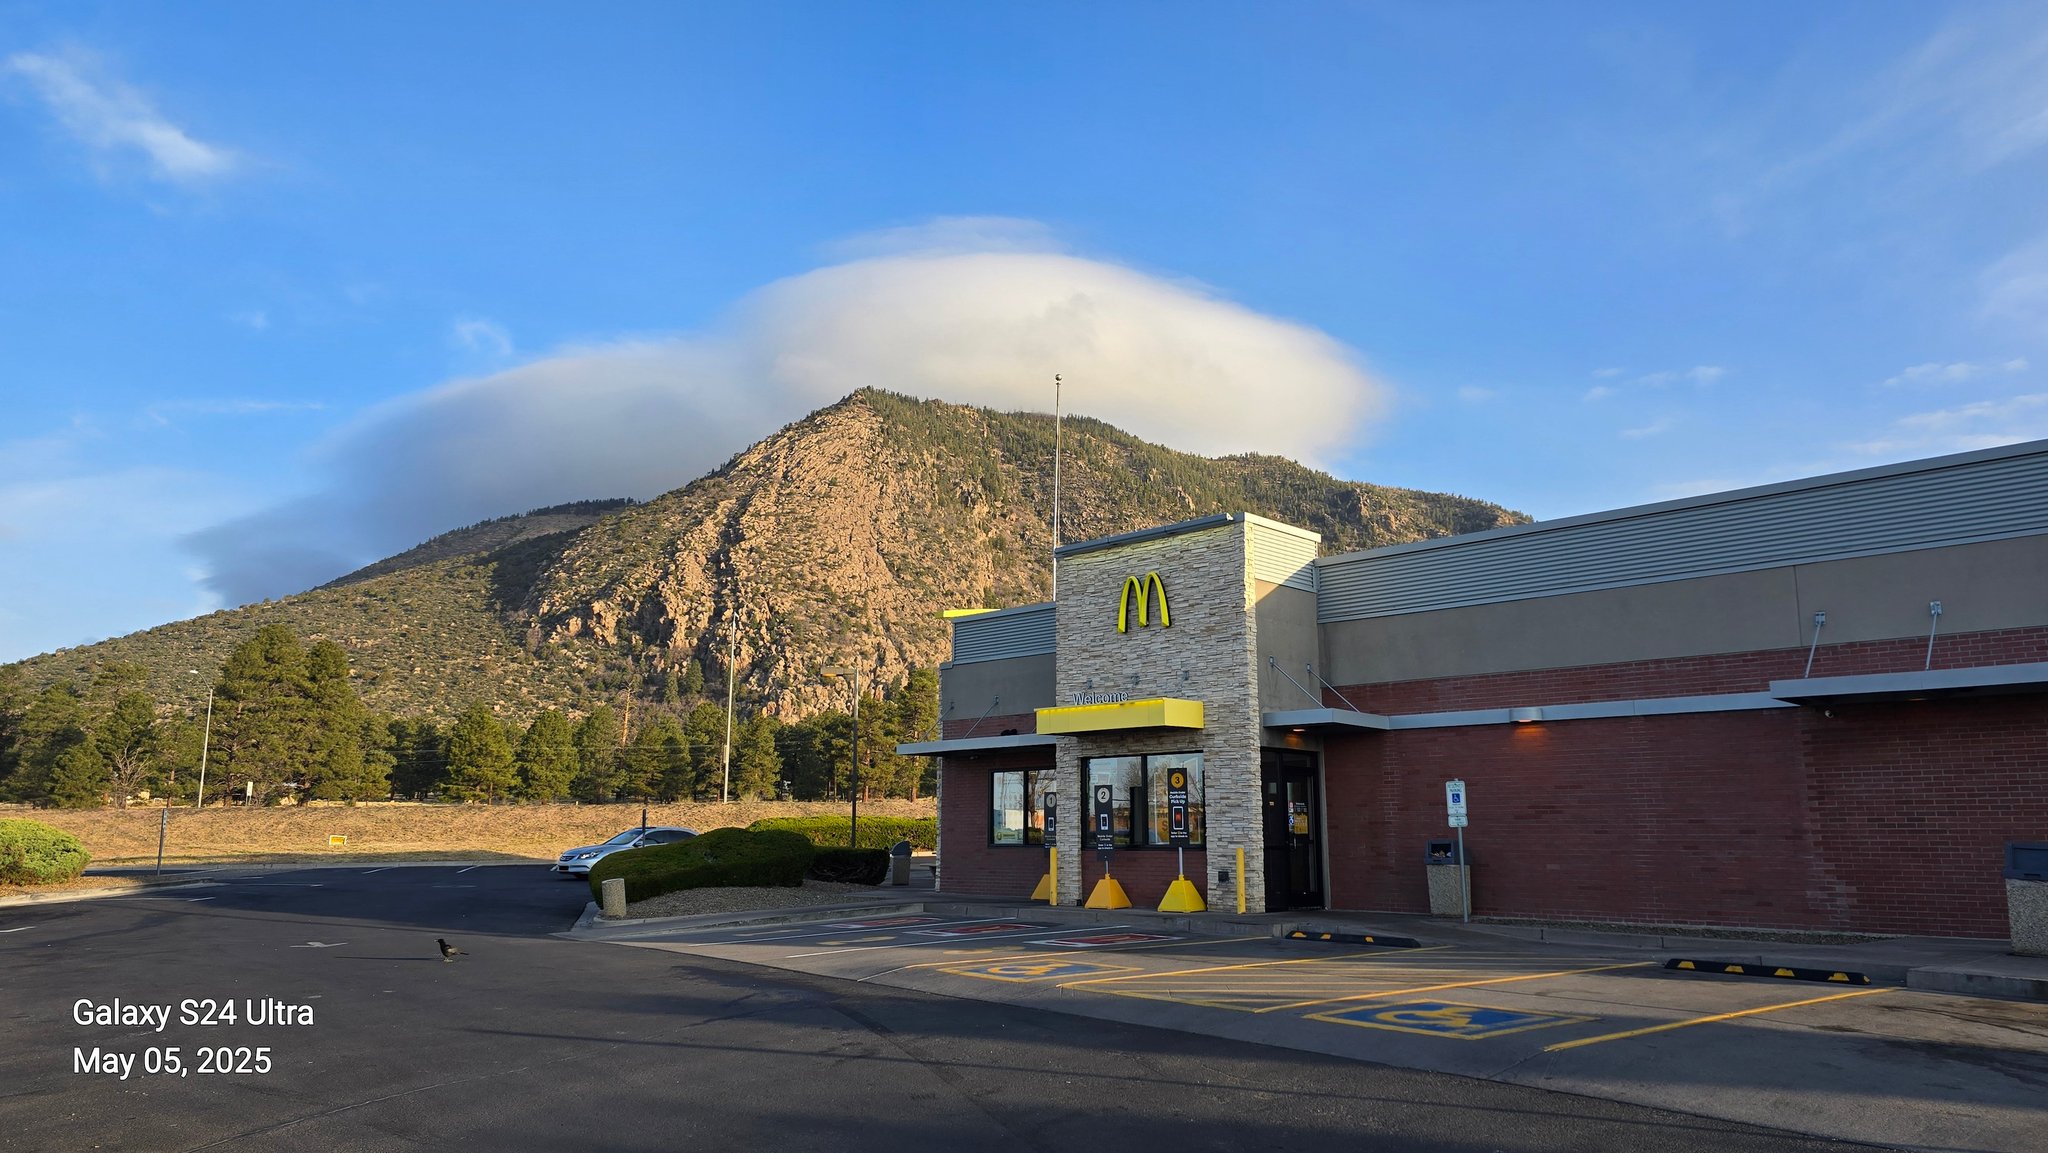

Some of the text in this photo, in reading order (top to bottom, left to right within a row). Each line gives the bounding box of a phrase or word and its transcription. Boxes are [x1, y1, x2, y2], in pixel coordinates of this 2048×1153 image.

[1073, 692, 1128, 706] Welcome
[1174, 776, 1180, 784] 3
[1101, 791, 1106, 800] 2
